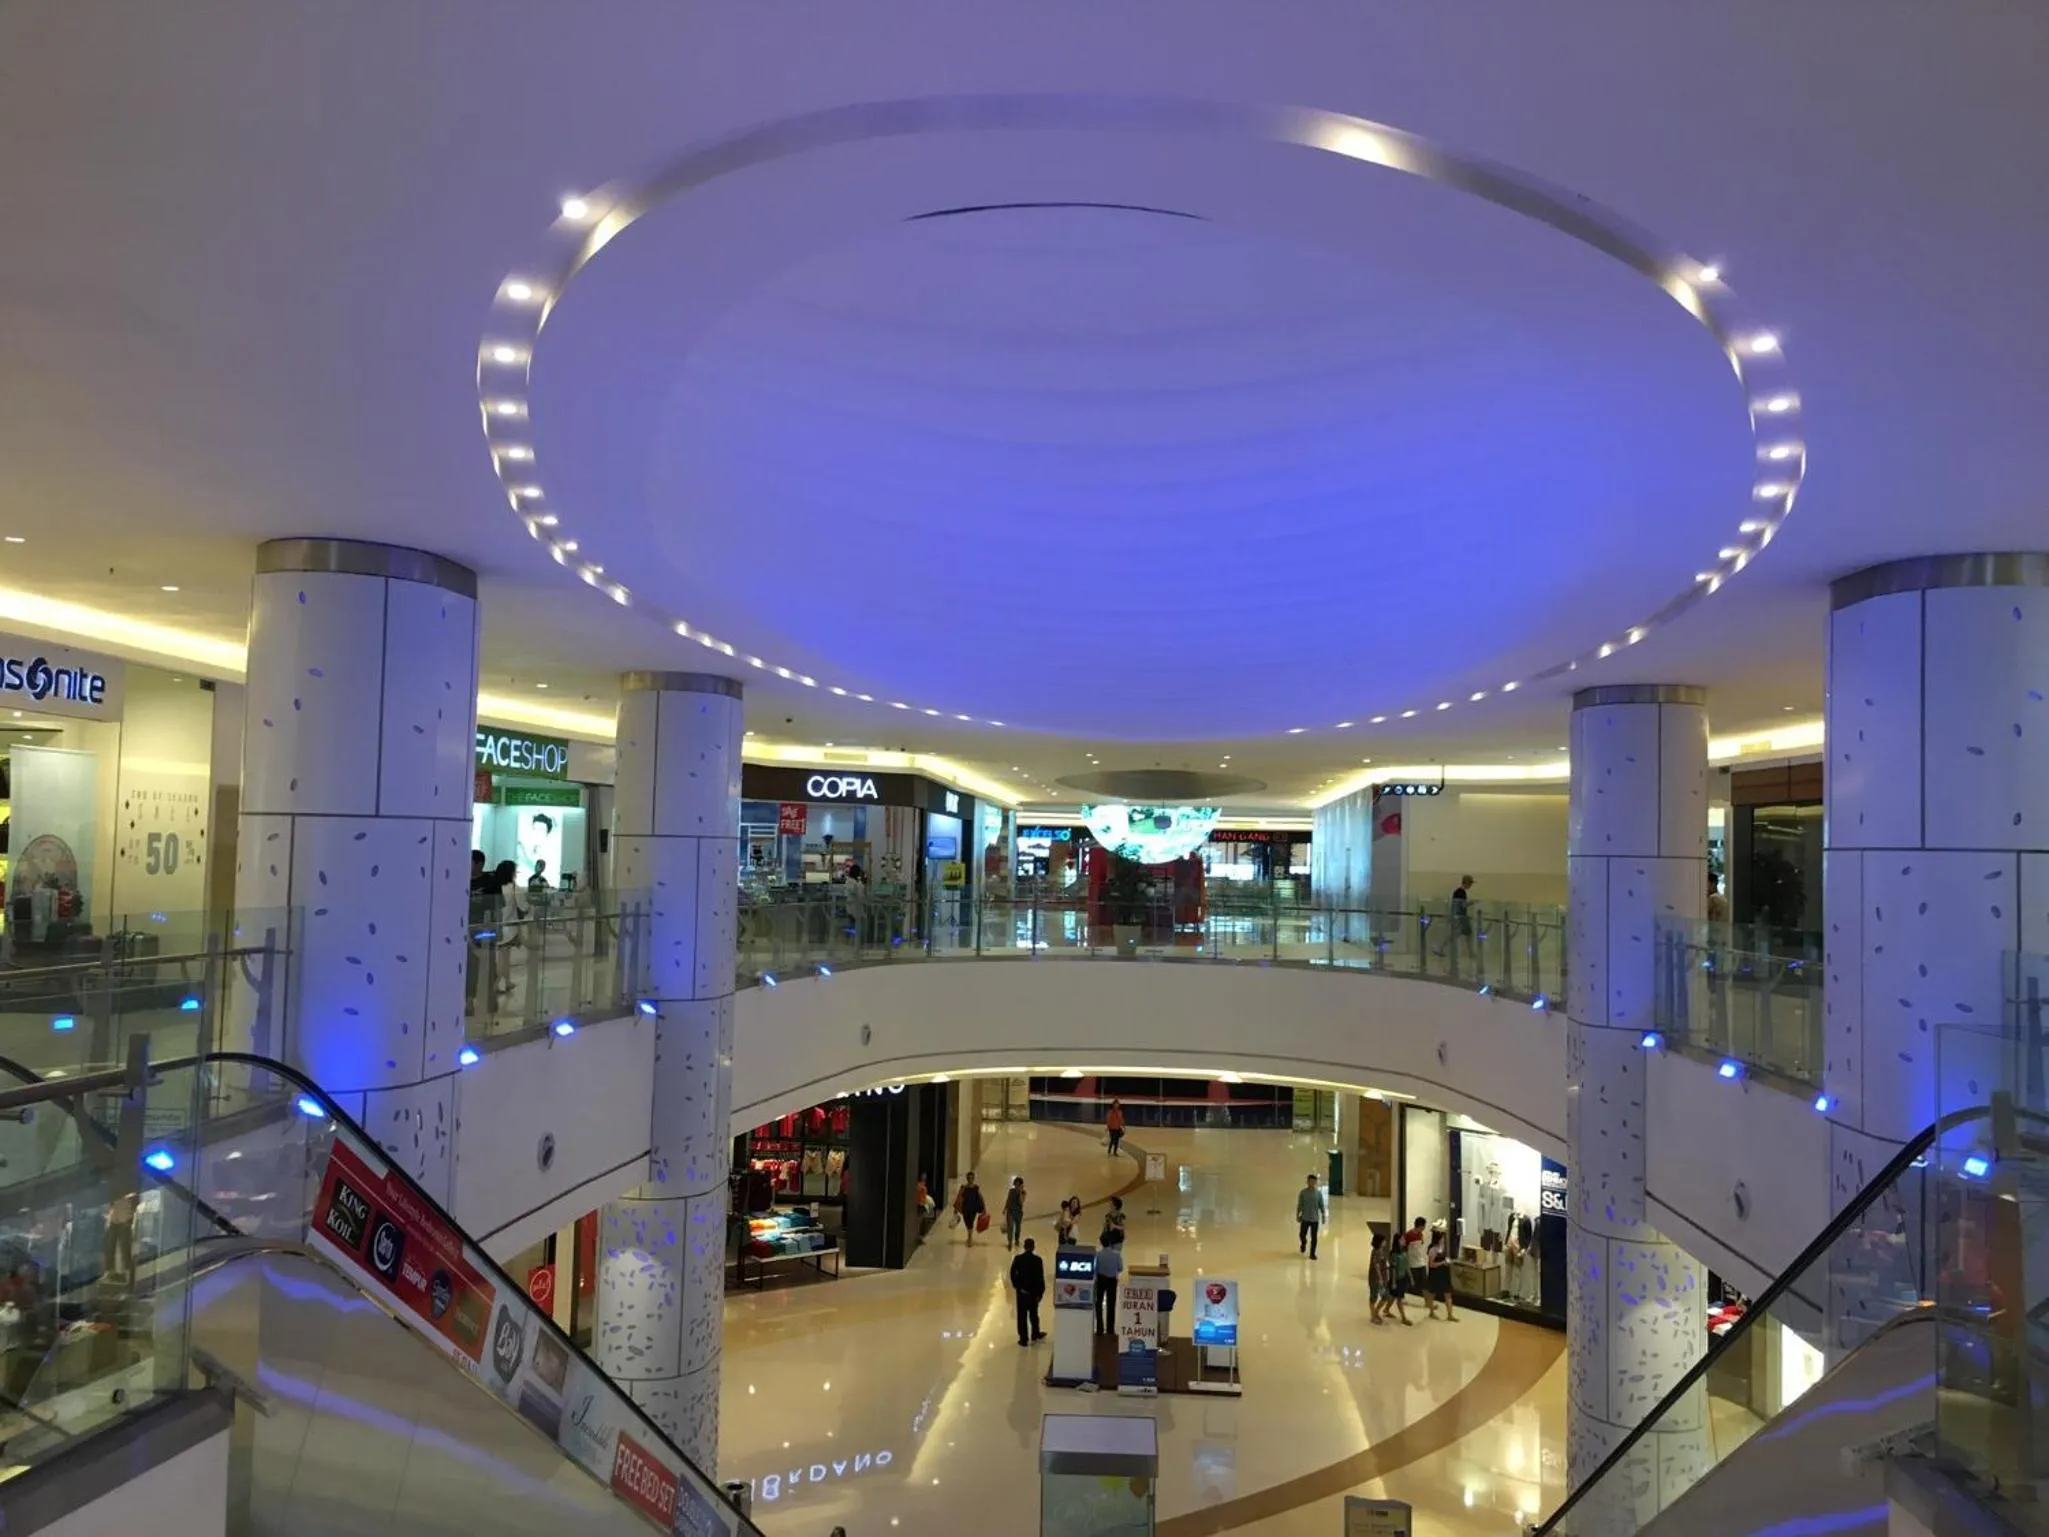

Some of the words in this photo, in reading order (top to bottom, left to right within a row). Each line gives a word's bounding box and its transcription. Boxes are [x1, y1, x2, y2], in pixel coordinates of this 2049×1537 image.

[806, 775, 879, 799] COPIA
[146, 832, 179, 875] 50
[339, 1184, 368, 1220] KING
[326, 1209, 353, 1241] KOIL
[1070, 1261, 1092, 1272] BCA
[1122, 1326, 1155, 1337] TAHUN
[1134, 1312, 1142, 1324] 1
[615, 1443, 643, 1491] FREE
[640, 1466, 660, 1504] BED
[659, 1481, 676, 1516] SET
